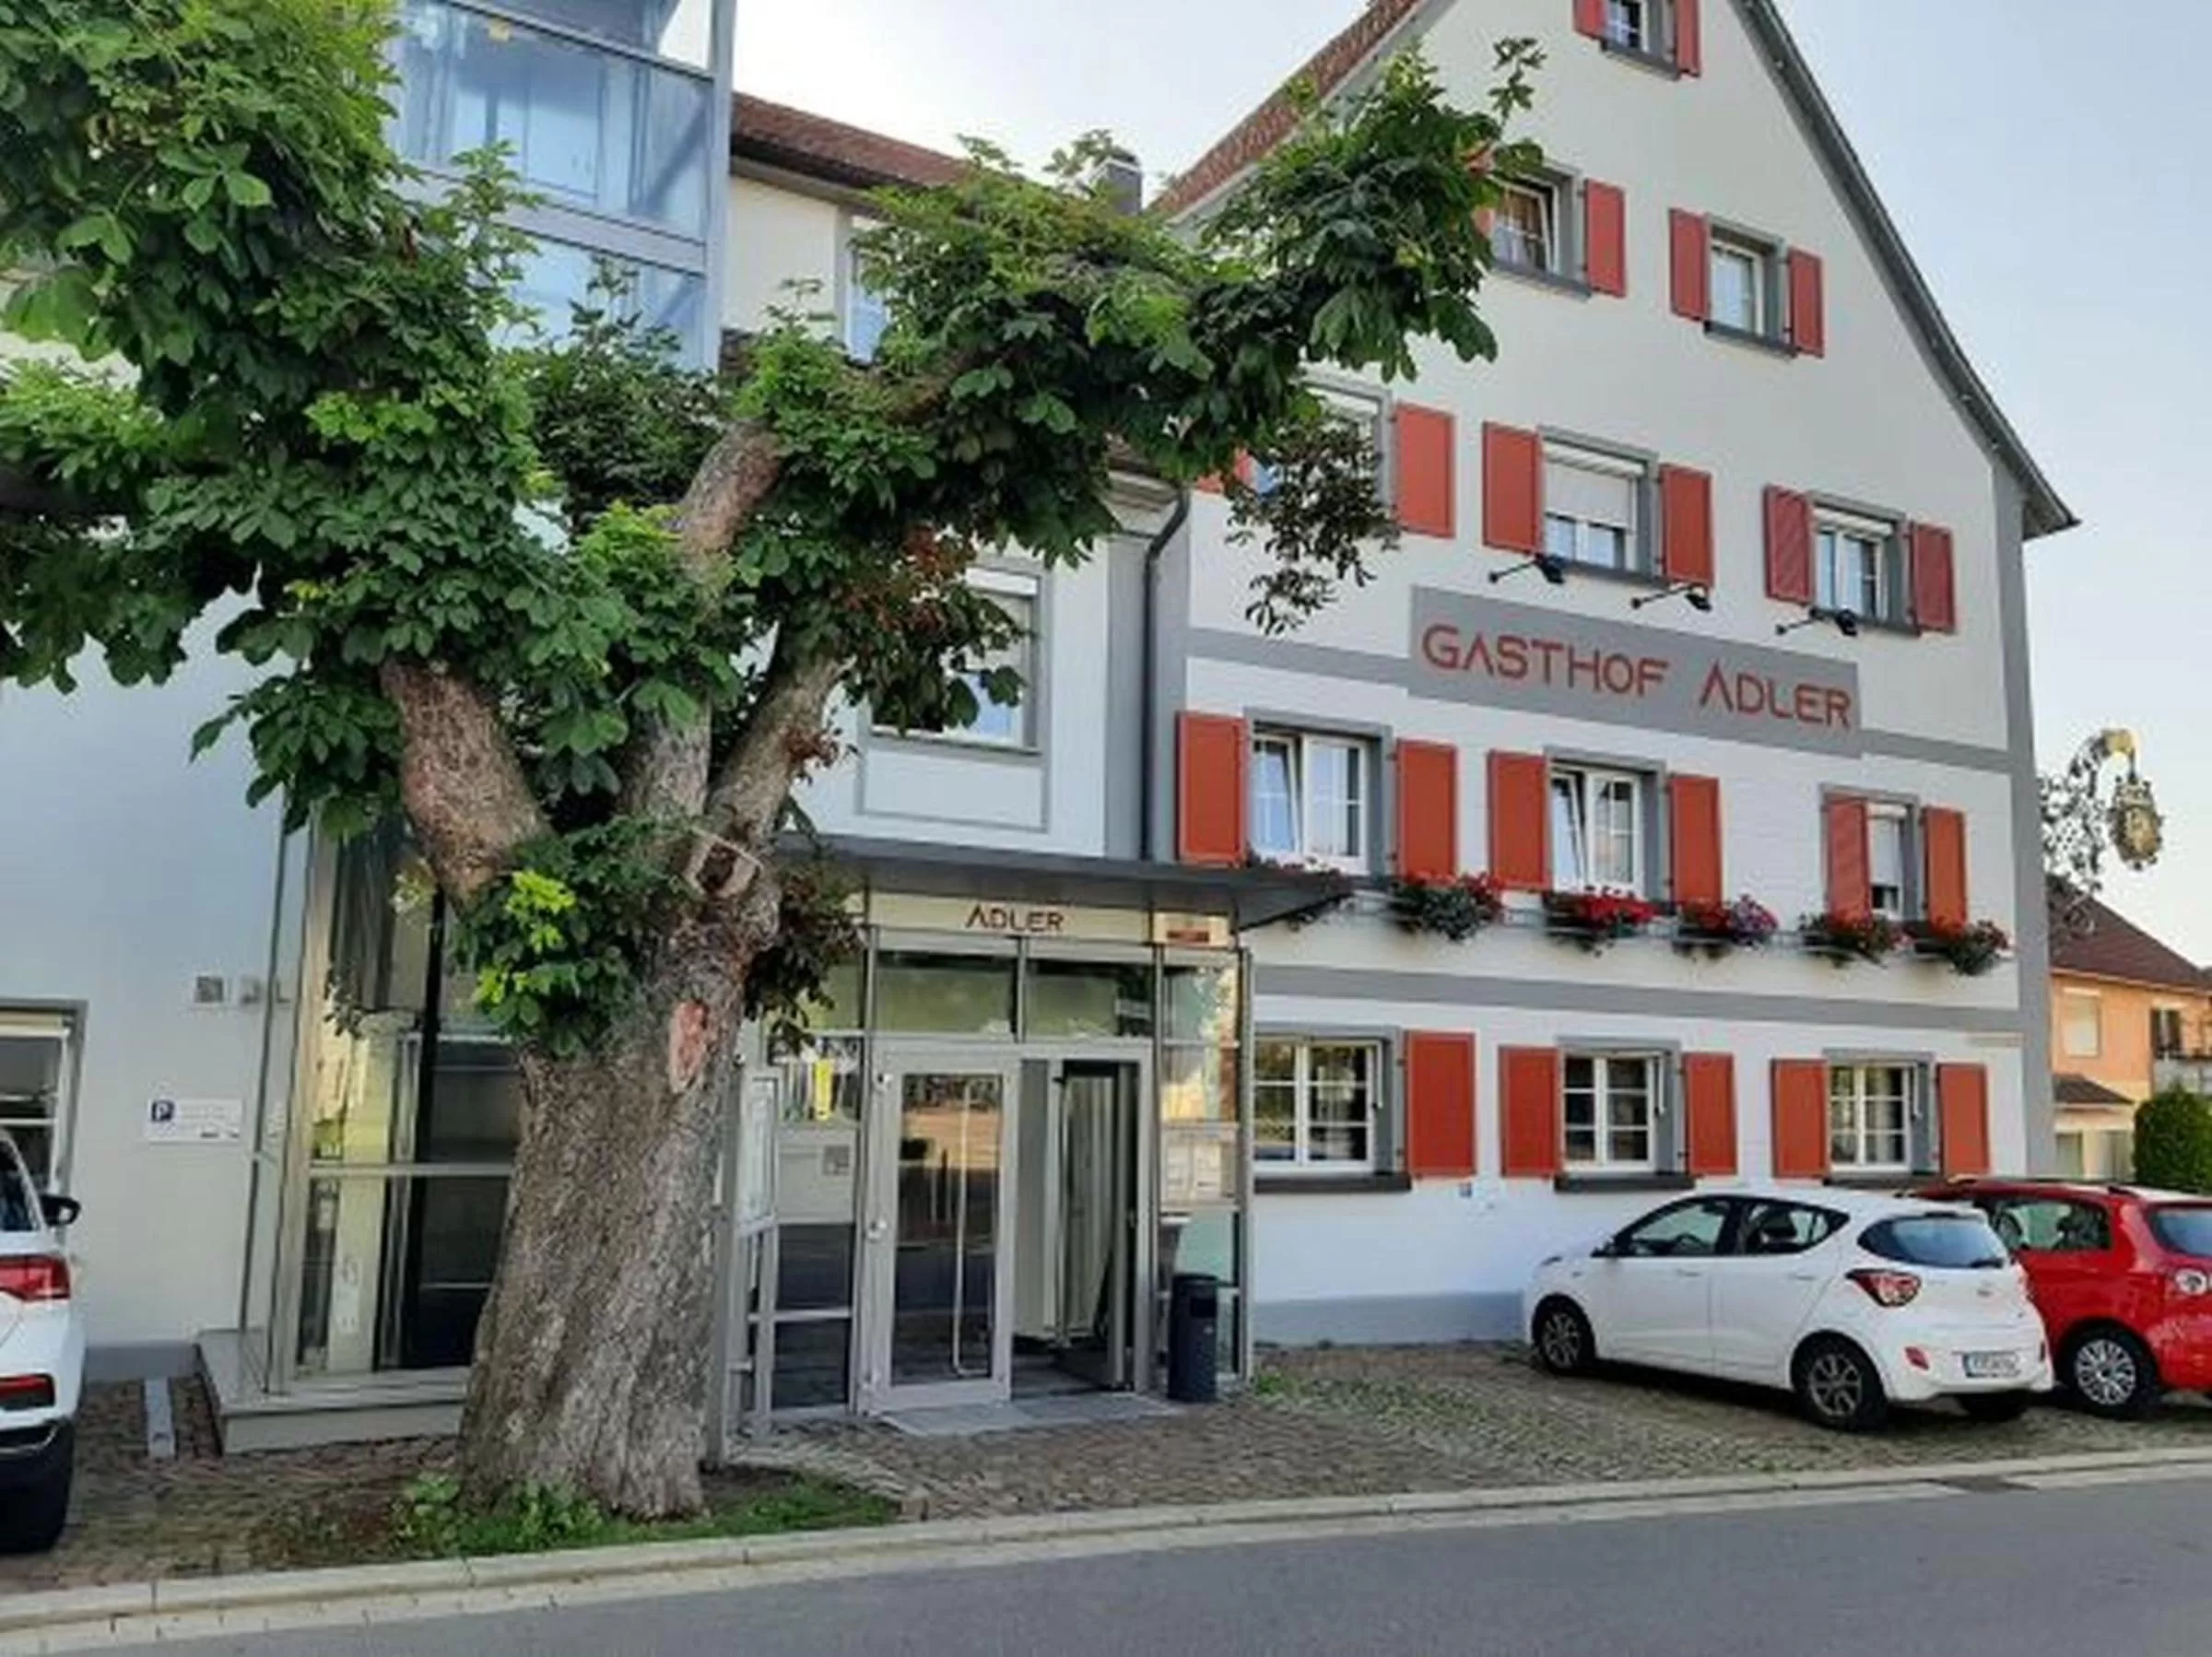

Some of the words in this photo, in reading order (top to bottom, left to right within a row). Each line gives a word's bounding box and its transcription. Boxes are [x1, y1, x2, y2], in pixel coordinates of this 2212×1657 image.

[1421, 623, 1670, 697] GASTHOF
[1699, 661, 1853, 729] ADLER
[965, 904, 1065, 933] ADLER
[155, 1102, 171, 1122] P
